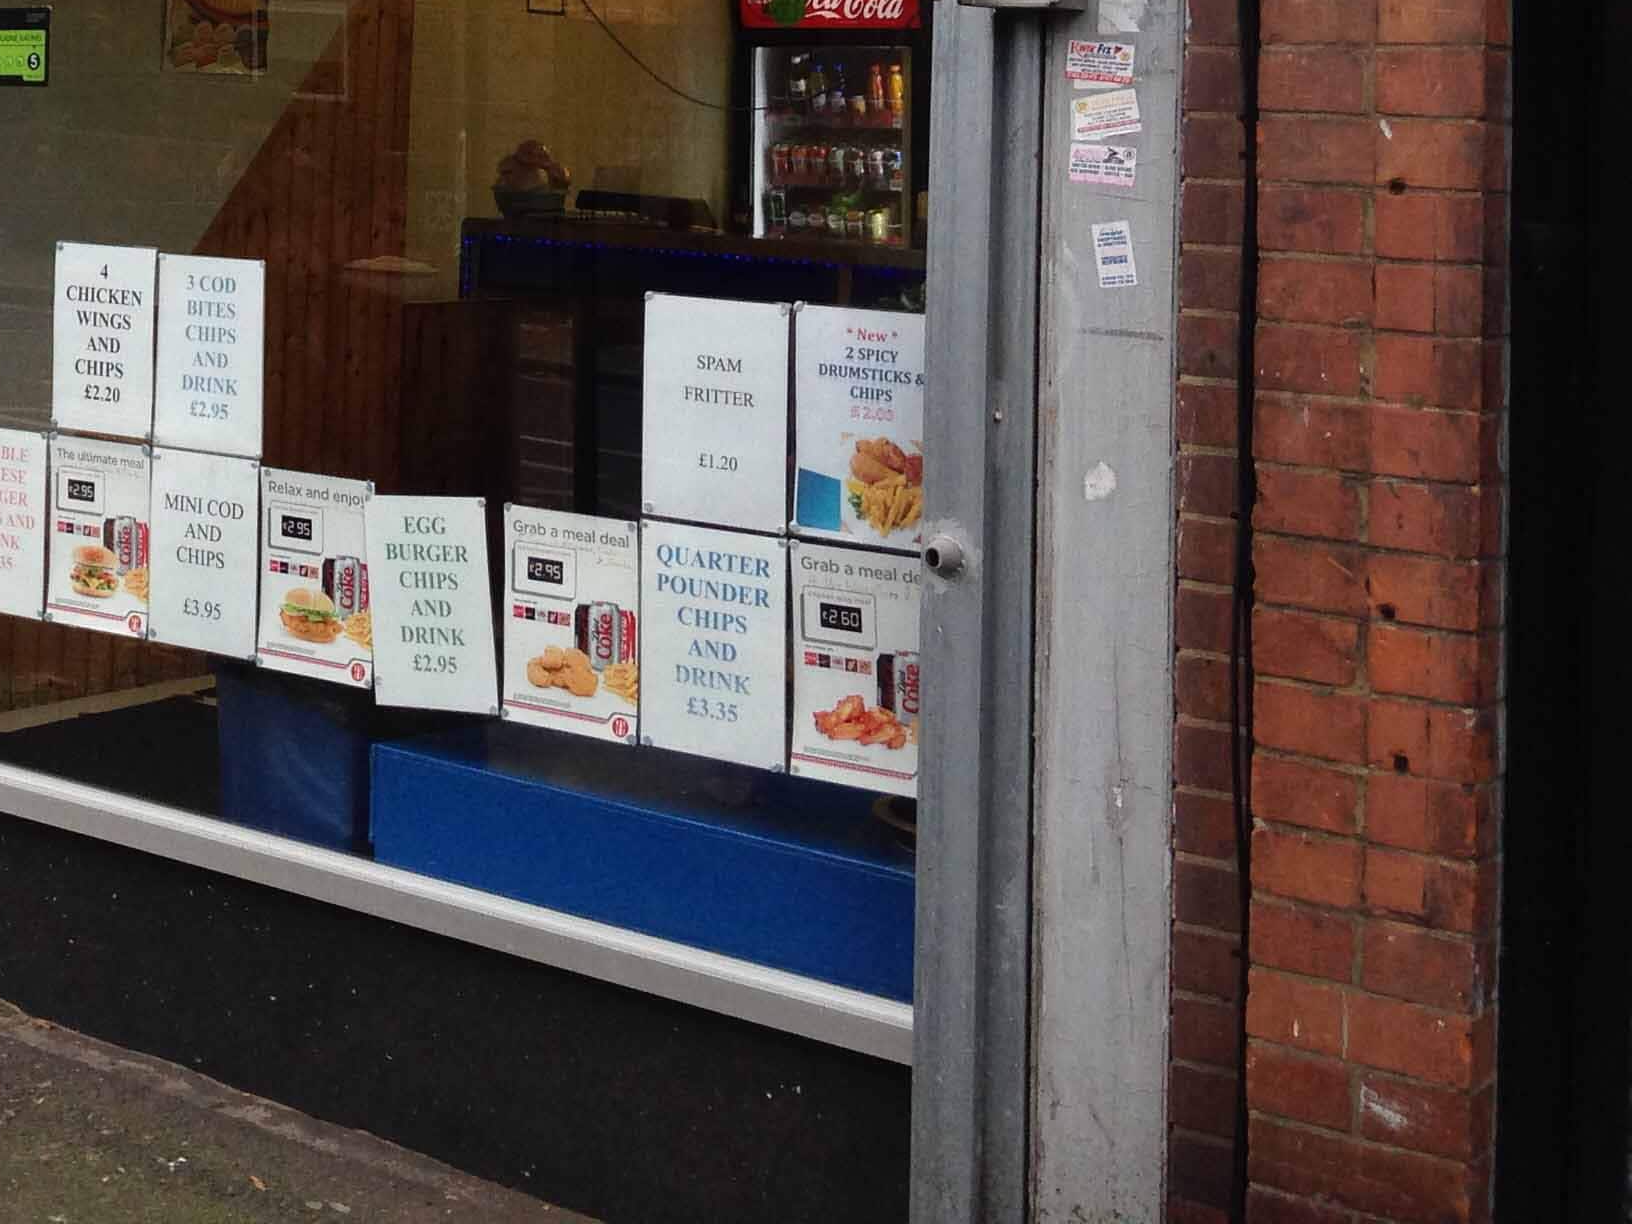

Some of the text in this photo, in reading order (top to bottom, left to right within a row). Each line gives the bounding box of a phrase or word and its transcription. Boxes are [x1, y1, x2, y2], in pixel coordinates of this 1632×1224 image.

[99, 263, 109, 280] 4
[186, 274, 237, 295] 3 COD
[66, 285, 143, 308] CHICKEN
[76, 310, 133, 331] WINGS
[186, 300, 236, 321] BITES
[86, 336, 121, 355] AND
[185, 324, 237, 345] CHIPS
[191, 350, 229, 370] AND
[696, 354, 743, 374] SPAM
[845, 346, 898, 364] 2 SPICY
[74, 358, 125, 380] CHIPS
[818, 363, 925, 385] DRUMSTICKS &
[84, 384, 121, 405] £2.20
[181, 374, 239, 397] DRINK
[683, 384, 755, 409] FRITTER
[850, 385, 893, 402] CHIPS
[189, 400, 229, 421] £2.95
[56, 447, 145, 469] The ultimate meal
[699, 452, 738, 473] £1.20
[268, 480, 303, 498] Relax
[306, 488, 330, 502] and
[164, 493, 244, 521] MINI COD
[7, 514, 35, 530] AND
[184, 523, 222, 543] AND
[403, 516, 446, 535] EGG
[512, 519, 630, 549] Grab a meal deal
[120, 526, 132, 566] Coke
[385, 543, 468, 563] BURGER
[176, 547, 225, 569] CHIPS
[656, 543, 771, 579] QUARTER
[800, 556, 840, 575] Grab
[844, 565, 854, 576] a
[858, 566, 897, 582] meal
[340, 566, 355, 610] Coke
[399, 571, 459, 591] CHIPS
[656, 572, 770, 608] POUNDER
[182, 598, 222, 621] £3.95
[410, 599, 452, 618] AND
[677, 605, 748, 634] CHIPS
[400, 625, 465, 647] DRINK
[596, 613, 613, 660] Coke
[688, 638, 738, 662] AND
[413, 653, 458, 674] £2.95
[675, 664, 751, 695] DRINK
[687, 695, 739, 722] £3.35
